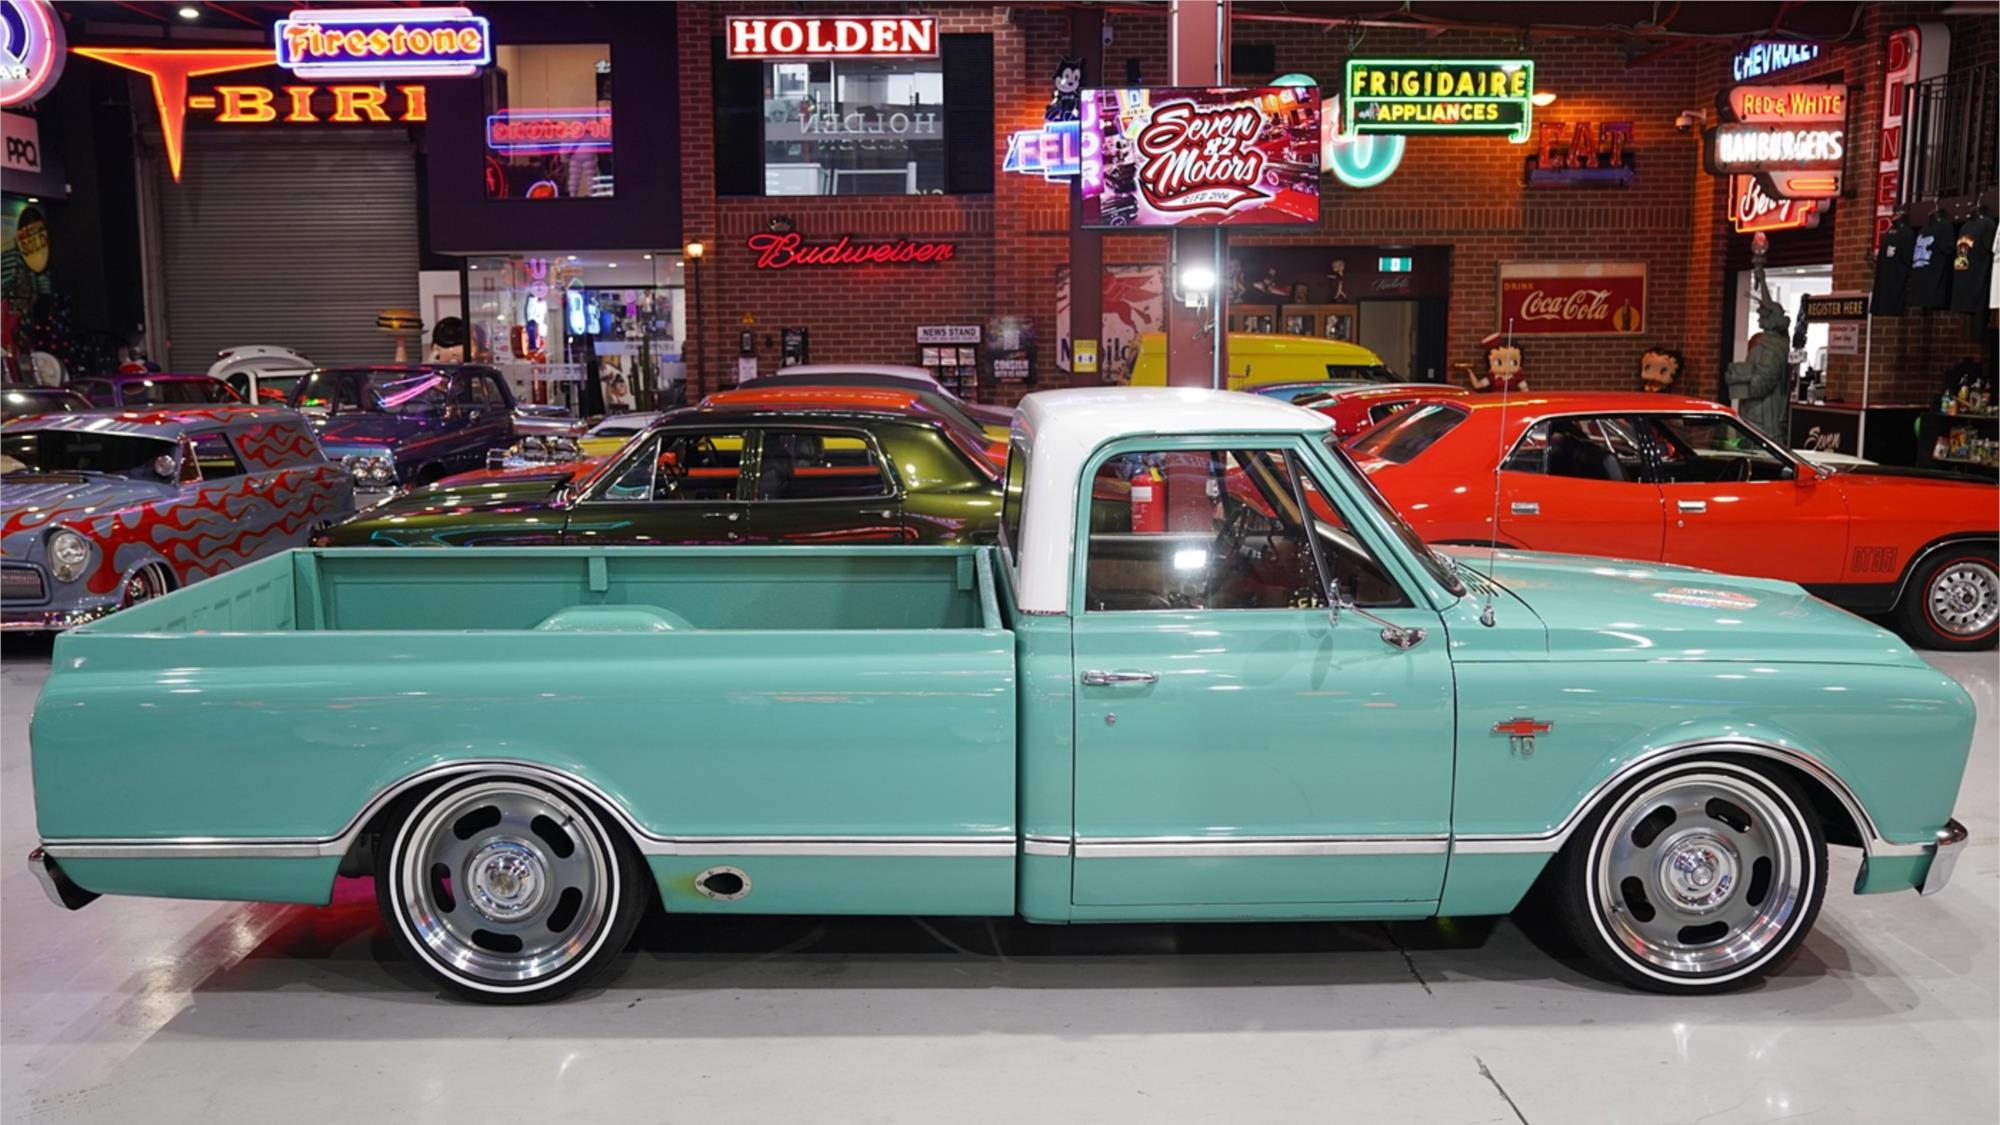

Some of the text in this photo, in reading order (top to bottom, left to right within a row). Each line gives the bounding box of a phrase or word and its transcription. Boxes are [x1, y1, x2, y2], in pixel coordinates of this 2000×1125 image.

[282, 24, 482, 62] Firestone
[732, 20, 932, 52] HOLDEN
[1734, 44, 1818, 81] CHEVROLET
[1353, 70, 1527, 97] FRIGIDAIRE
[1377, 103, 1499, 121] APPLIANCES
[1744, 93, 1773, 115] RED
[1791, 92, 1841, 115] WHITE
[1143, 108, 1254, 154] Seven
[1203, 137, 1237, 156] 82
[1539, 122, 1634, 168] EAT
[1719, 130, 1844, 162] HAMBURGERS
[7, 136, 38, 167] PPQ
[1145, 148, 1258, 194] Motors
[748, 233, 954, 269] Budweiser
[1504, 282, 1535, 291] DRINK
[1520, 289, 1614, 321] Coca-Cola
[1808, 301, 1863, 316] REGISTER HERE
[922, 328, 977, 336] NEWS STAND
